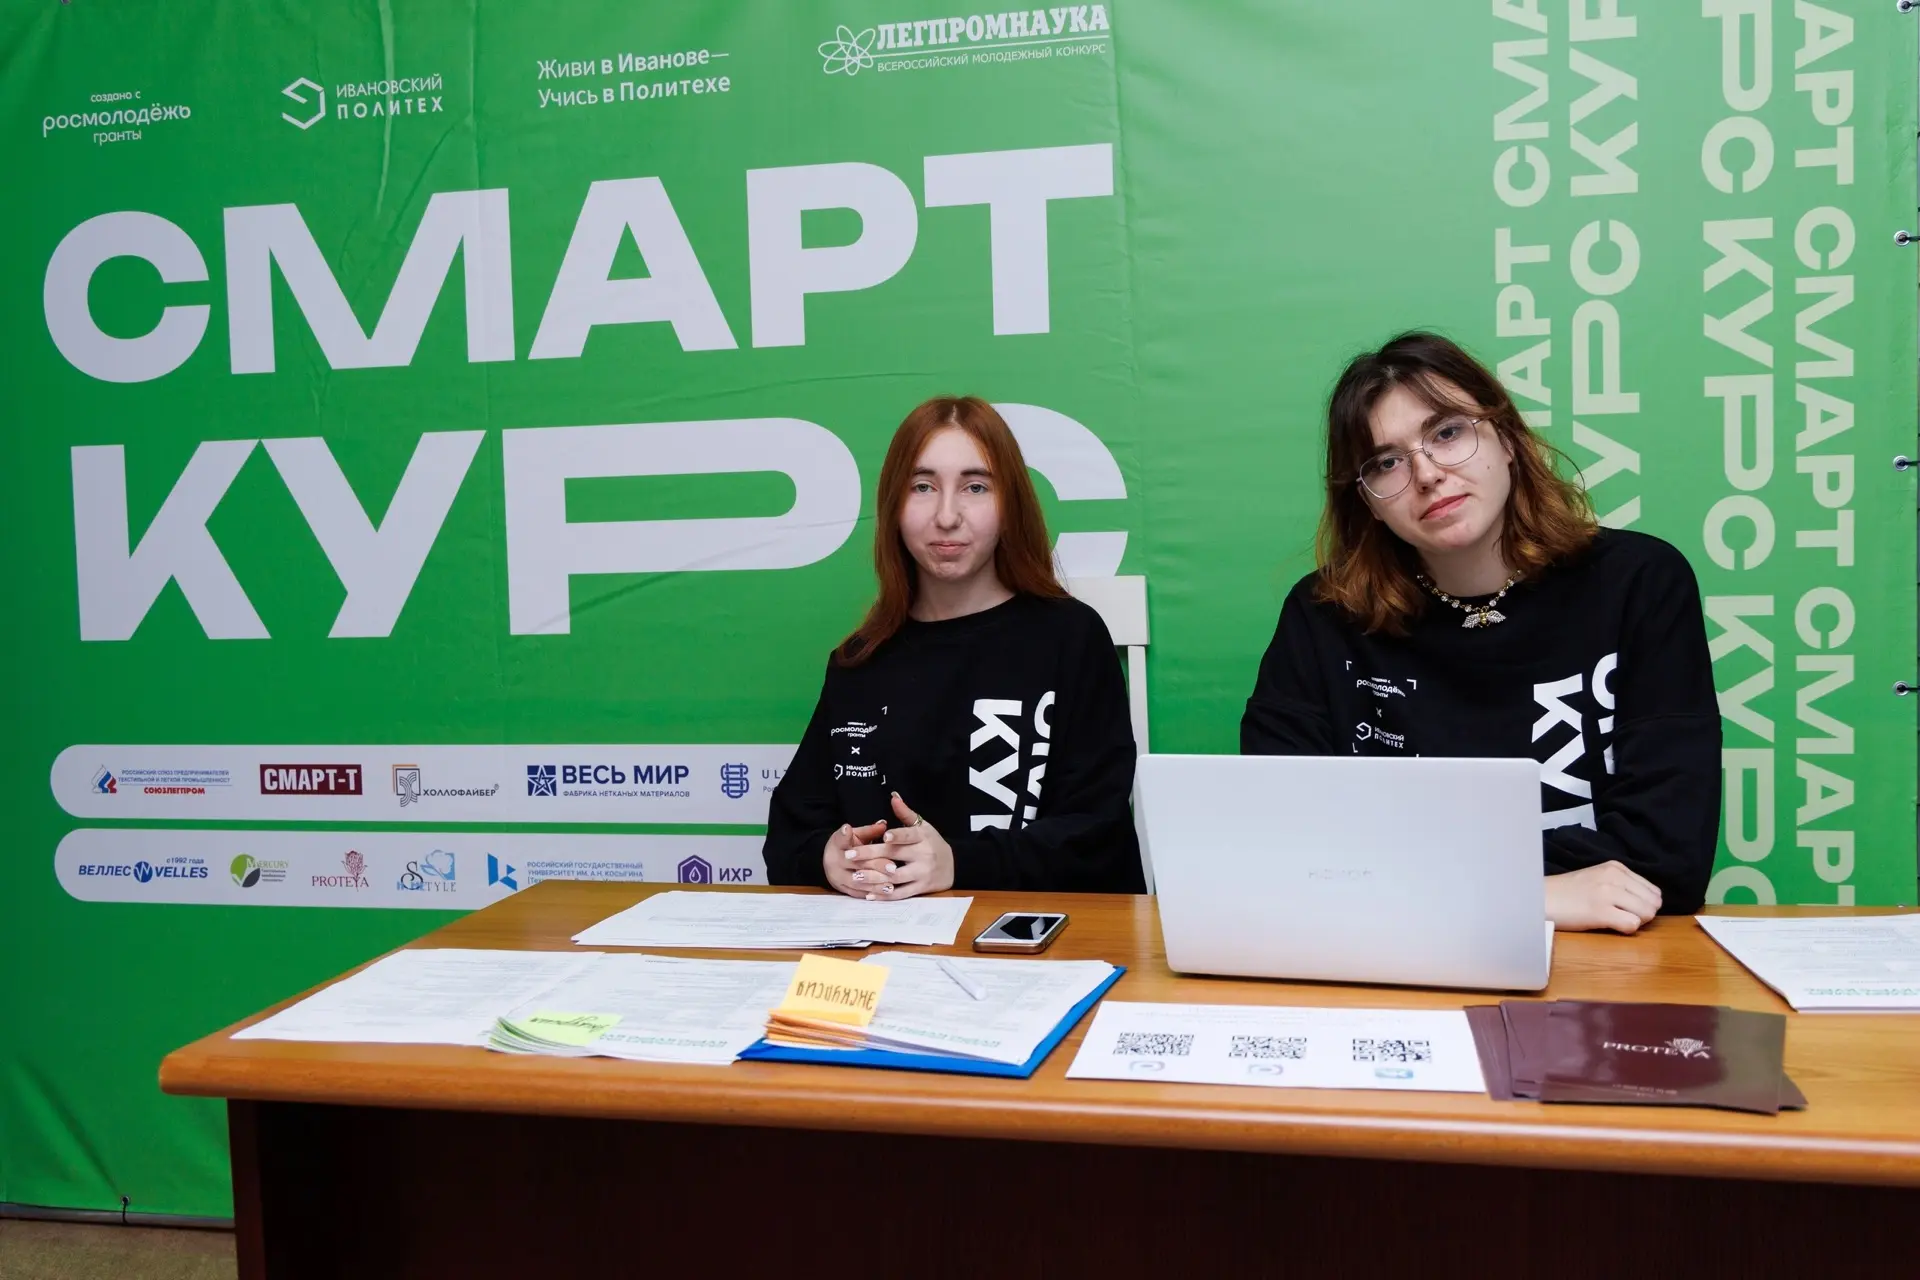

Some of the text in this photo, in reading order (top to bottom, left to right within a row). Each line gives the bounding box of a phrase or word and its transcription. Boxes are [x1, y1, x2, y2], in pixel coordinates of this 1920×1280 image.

[876, 4, 1110, 50] ЛЕГПРОМНАУКА
[877, 43, 1106, 72] ВСЕРОССИЙСКИЙ МОЛОДЕЖНЫЙ КОНКУРС
[537, 58, 596, 80] Живи
[601, 59, 613, 75] в
[336, 73, 442, 98] ИВАНОВСКИЙ
[537, 74, 731, 108] Учись в Политехе
[90, 91, 141, 103] создано с
[337, 96, 444, 120] ПОЛИТЕХ
[42, 103, 191, 138] росмолодёжь
[93, 129, 142, 146] гранты
[43, 143, 1114, 383] СМАРТ
[1572, 220, 1640, 530] УРС
[1703, 217, 1774, 568] КУРС
[1794, 206, 1855, 567] СМАРТ
[264, 768, 358, 791] СМАРТ-Т
[562, 765, 690, 784] ВЕСЬ МИР
[143, 786, 206, 795] СОЮЗЛЕГПРОМ
[640, 790, 690, 798] МАТЕРИАЛОВ
[78, 865, 208, 878] ВЕЛЛЕС VELLES
[526, 860, 643, 870] РОССИЙСКИЙ ГОСУДАРСТВЕННЫЙ
[527, 869, 575, 877] УНИВЕРСИТЕТ
[604, 870, 643, 878] КОСЫГИНА
[719, 867, 752, 882] ИХР
[311, 875, 369, 888] PROTEYA
